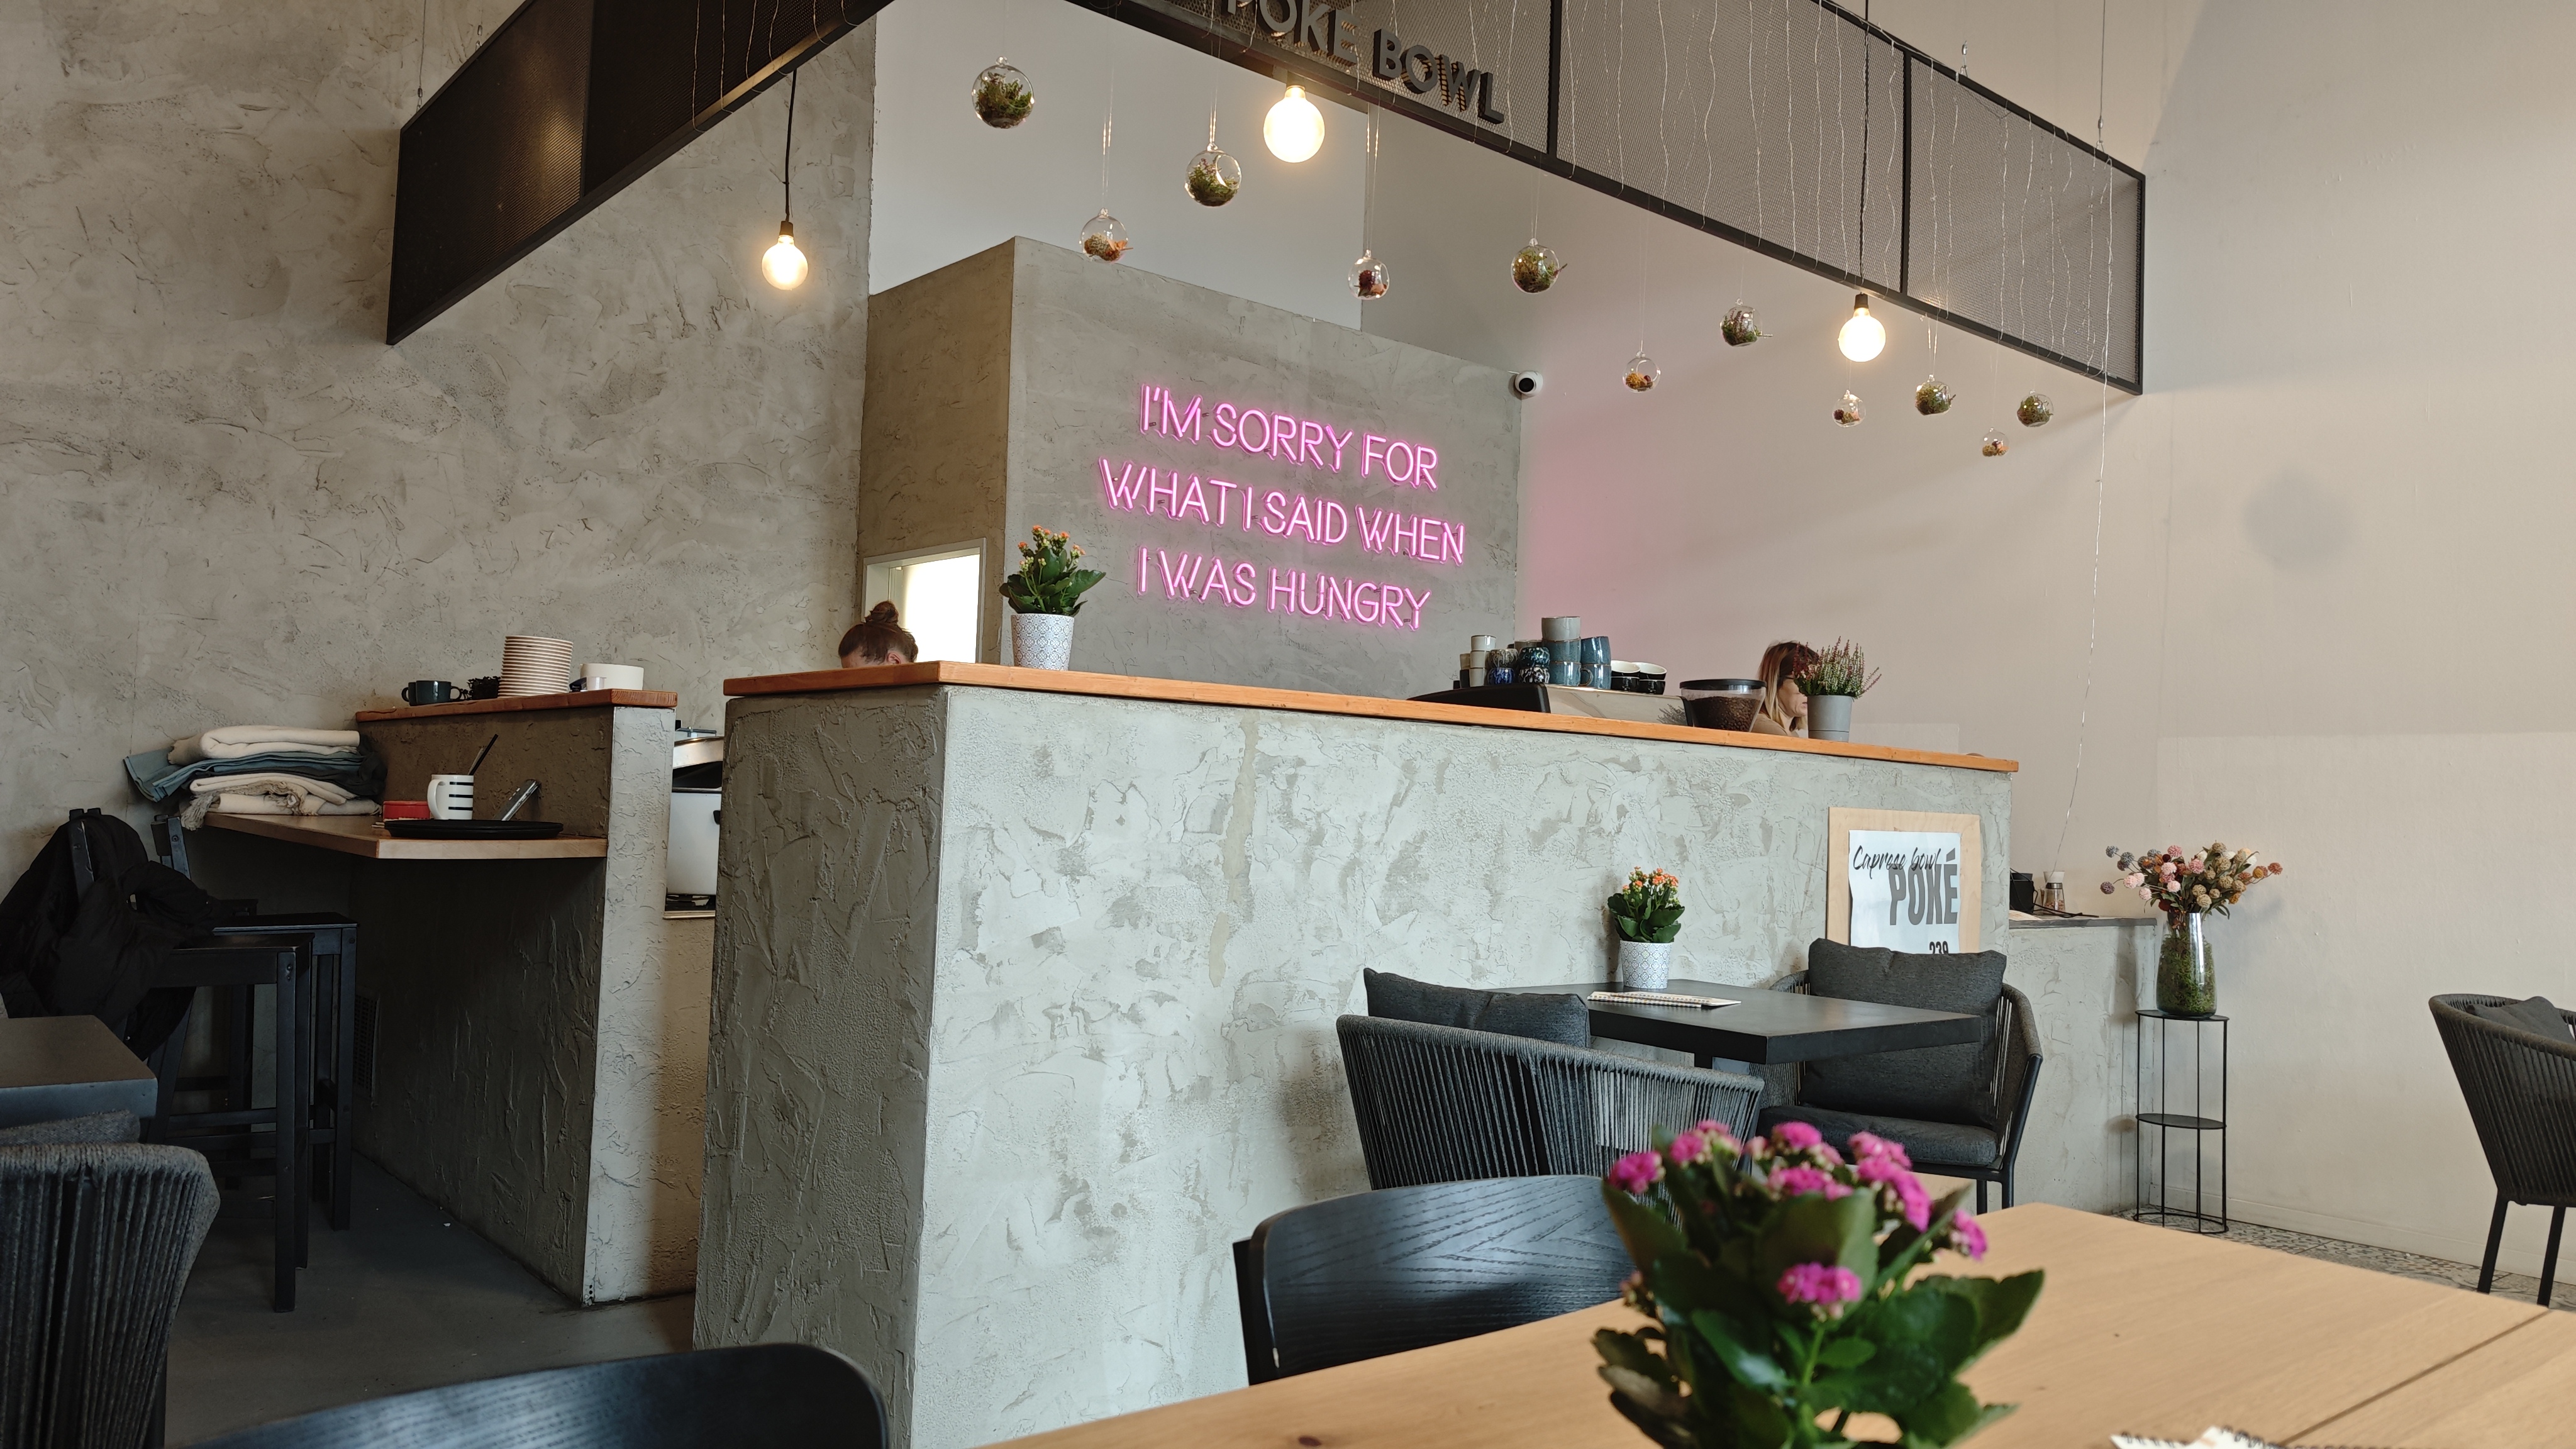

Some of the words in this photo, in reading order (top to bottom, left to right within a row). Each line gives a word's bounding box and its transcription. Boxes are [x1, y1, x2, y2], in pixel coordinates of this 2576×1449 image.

[1221, 0, 1358, 67] OKE
[1372, 28, 1504, 125] BOWL
[1140, 384, 1202, 444] I'M
[1212, 402, 1354, 473] SORRY
[1361, 432, 1438, 491] FOR
[1099, 457, 1238, 528] WHAT
[1243, 486, 1254, 531] I
[1262, 491, 1348, 545] SAID
[1355, 504, 1465, 565] WHEN
[1137, 546, 1149, 595] I
[1157, 548, 1257, 606] WAS
[1267, 567, 1432, 631] HUNGRY
[1853, 845, 1908, 880] Caprese
[1911, 847, 1941, 872] bowl
[1888, 847, 1958, 926] POKÉ
